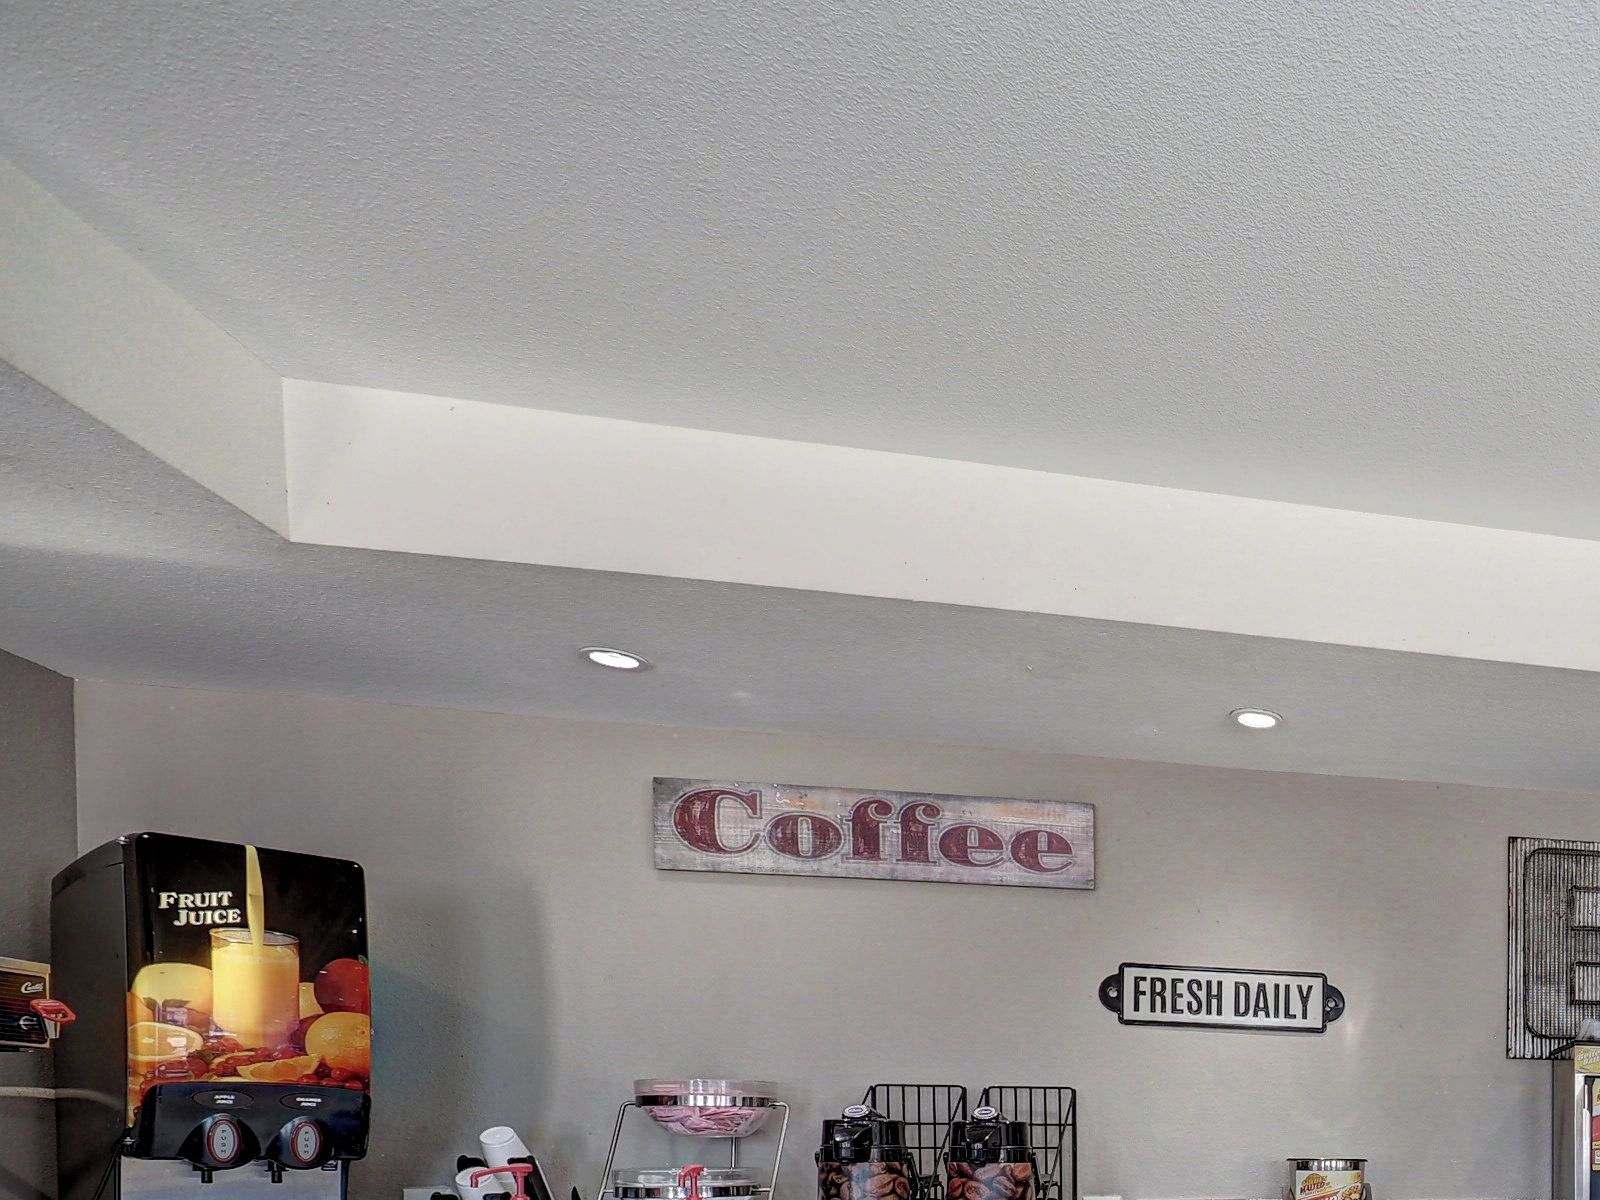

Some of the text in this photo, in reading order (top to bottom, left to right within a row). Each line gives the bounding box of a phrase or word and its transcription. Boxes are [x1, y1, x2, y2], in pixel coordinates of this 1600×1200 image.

[671, 788, 1075, 874] Coffee
[158, 890, 233, 909] FRUIT
[173, 908, 241, 926] JUICE
[1133, 975, 1315, 1021] FRESH DAILY
